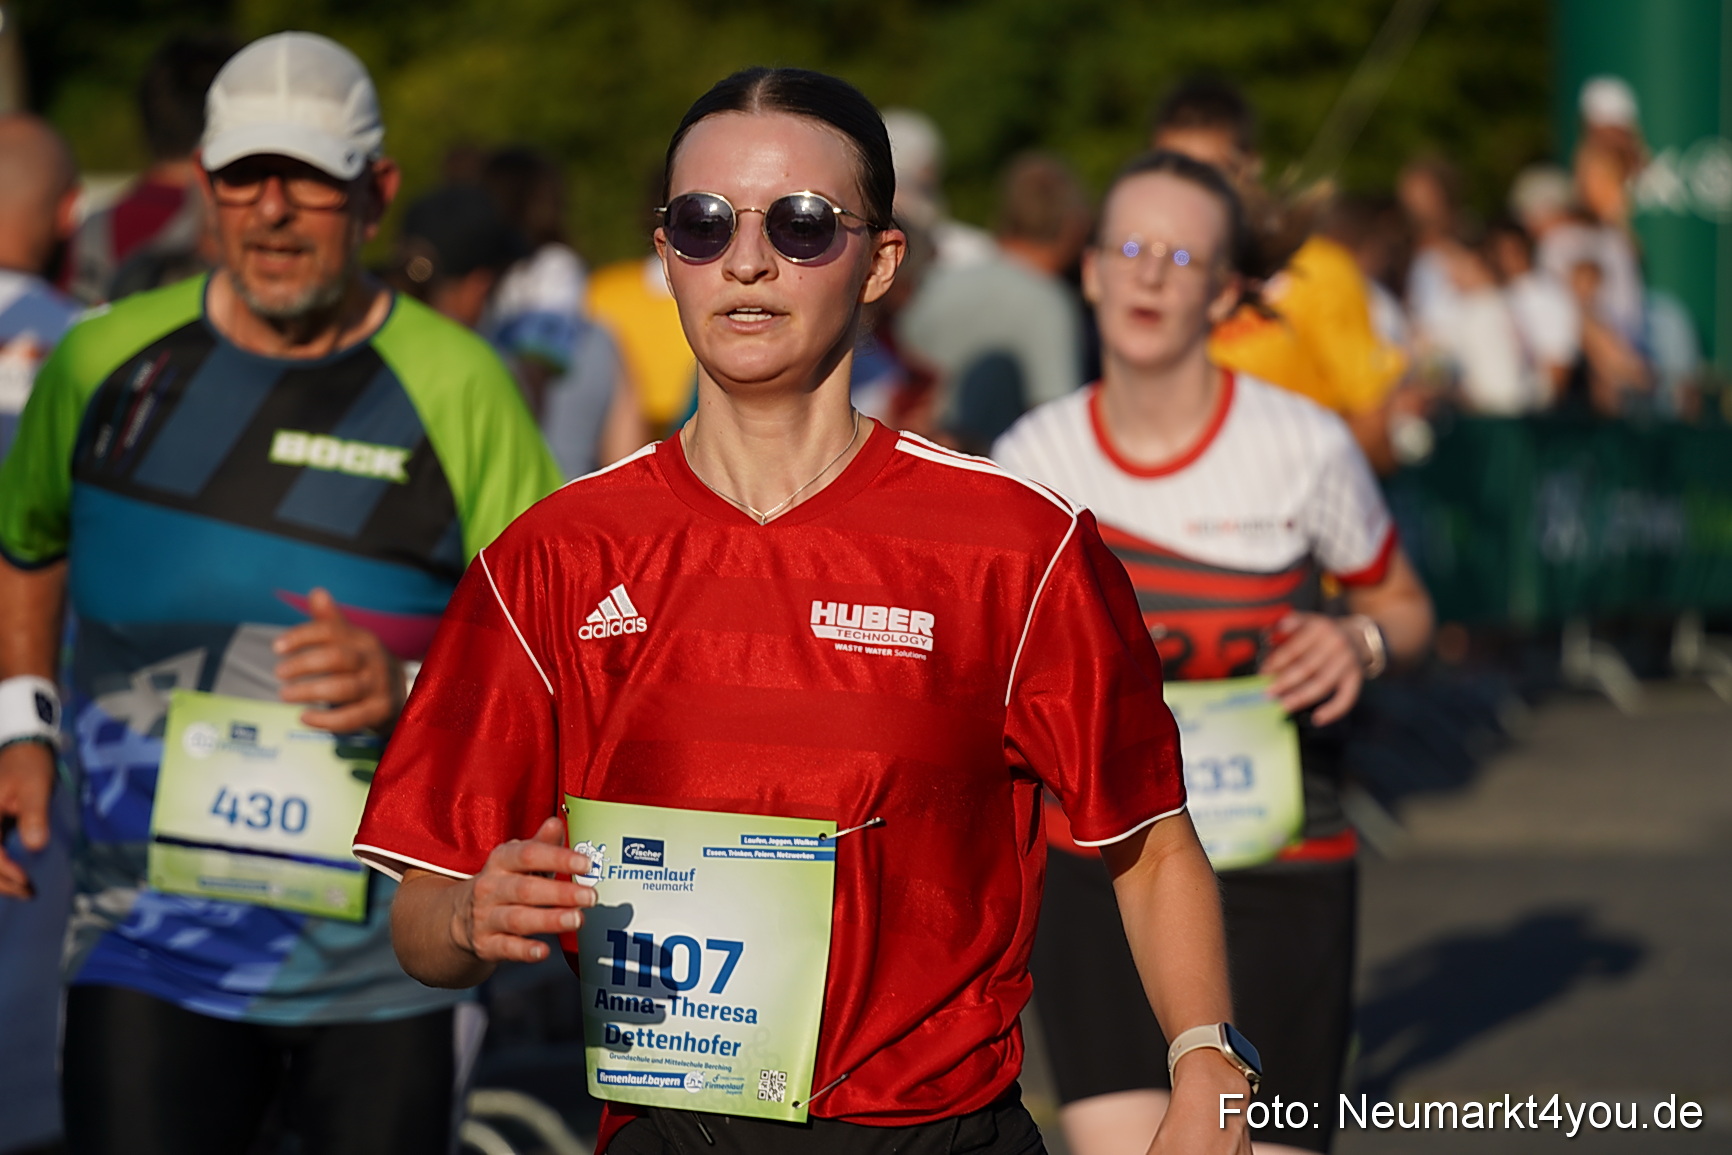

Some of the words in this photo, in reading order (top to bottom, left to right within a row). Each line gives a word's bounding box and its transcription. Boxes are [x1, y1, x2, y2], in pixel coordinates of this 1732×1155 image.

[269, 430, 411, 483] BOCK
[578, 616, 648, 640] adidas
[810, 600, 935, 637] HUBER
[836, 629, 928, 646] TECHNOLOGY
[834, 643, 863, 653] WASTE
[865, 646, 893, 656] WATER
[894, 648, 927, 661] Solutions
[211, 786, 309, 835] 430
[743, 836, 768, 845] Laufen,
[629, 846, 662, 859] Fischer
[608, 865, 696, 882] Firmenlauf
[642, 881, 694, 892] neumarkt
[607, 929, 744, 995] 1107
[594, 988, 758, 1025] Anna-Theresa
[605, 1023, 741, 1057] Dettenhofer
[609, 1051, 650, 1063] Grundschule
[651, 1056, 664, 1065] und
[664, 1057, 704, 1069] Mittelschule
[704, 1061, 732, 1073] Berching
[599, 1071, 680, 1087] firmenlauf.bayern
